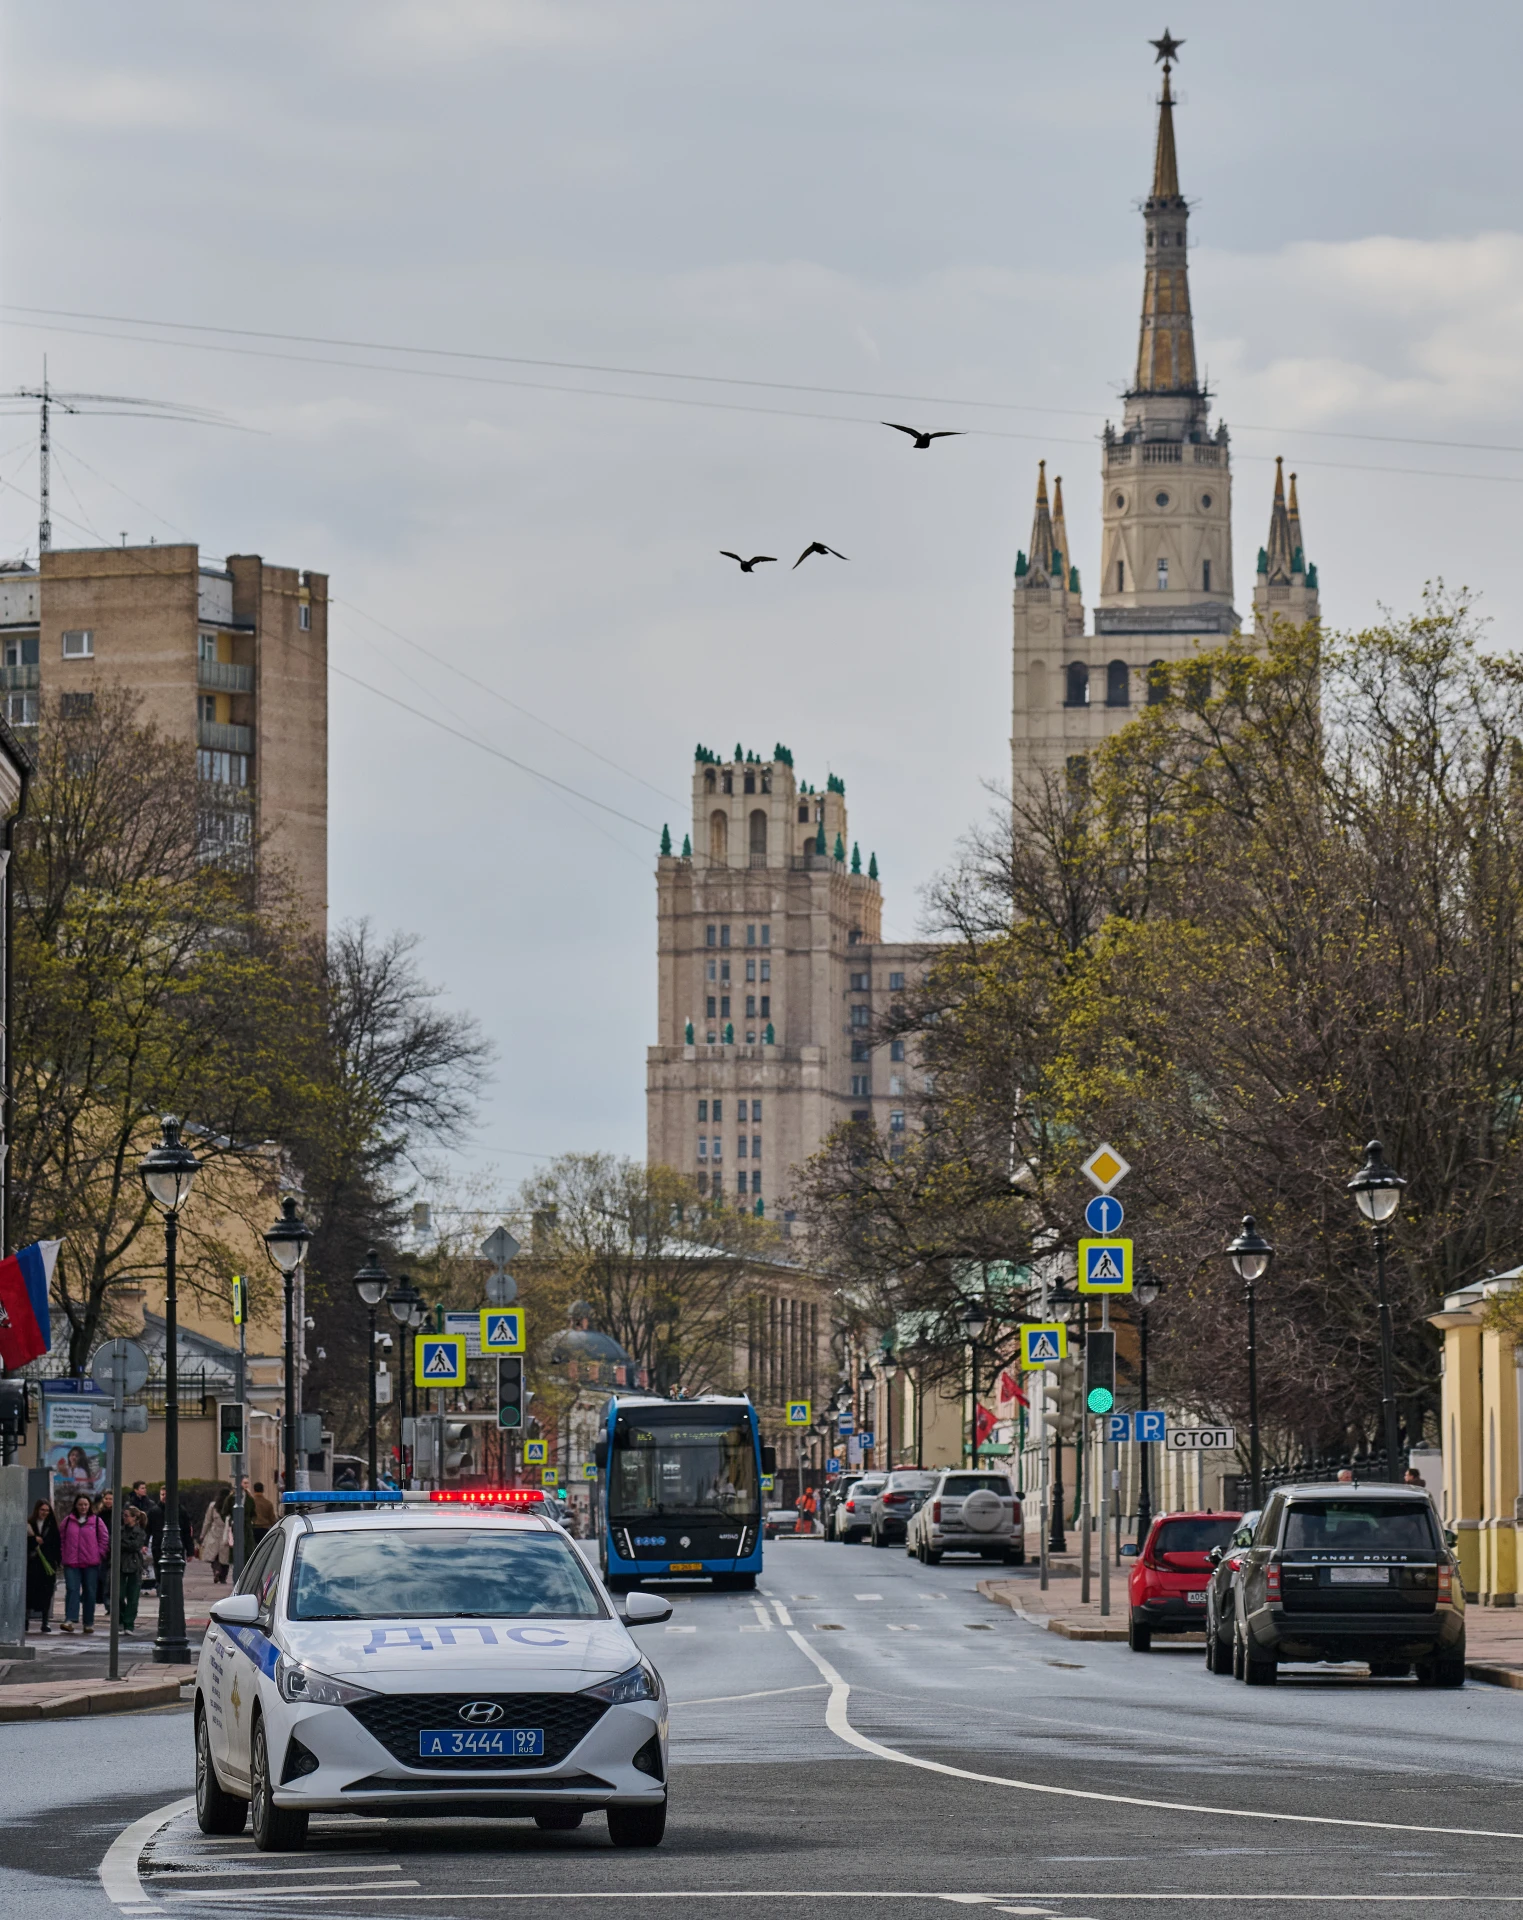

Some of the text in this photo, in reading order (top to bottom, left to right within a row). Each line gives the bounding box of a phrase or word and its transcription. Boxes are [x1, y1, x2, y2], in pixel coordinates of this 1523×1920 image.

[1109, 1417, 1124, 1439] P
[1143, 1415, 1160, 1438] P
[861, 1434, 870, 1447] P
[1174, 1431, 1227, 1447] СТОП
[363, 1626, 570, 1654] ДПС
[451, 1732, 503, 1753] 3444
[516, 1731, 537, 1746] 99
